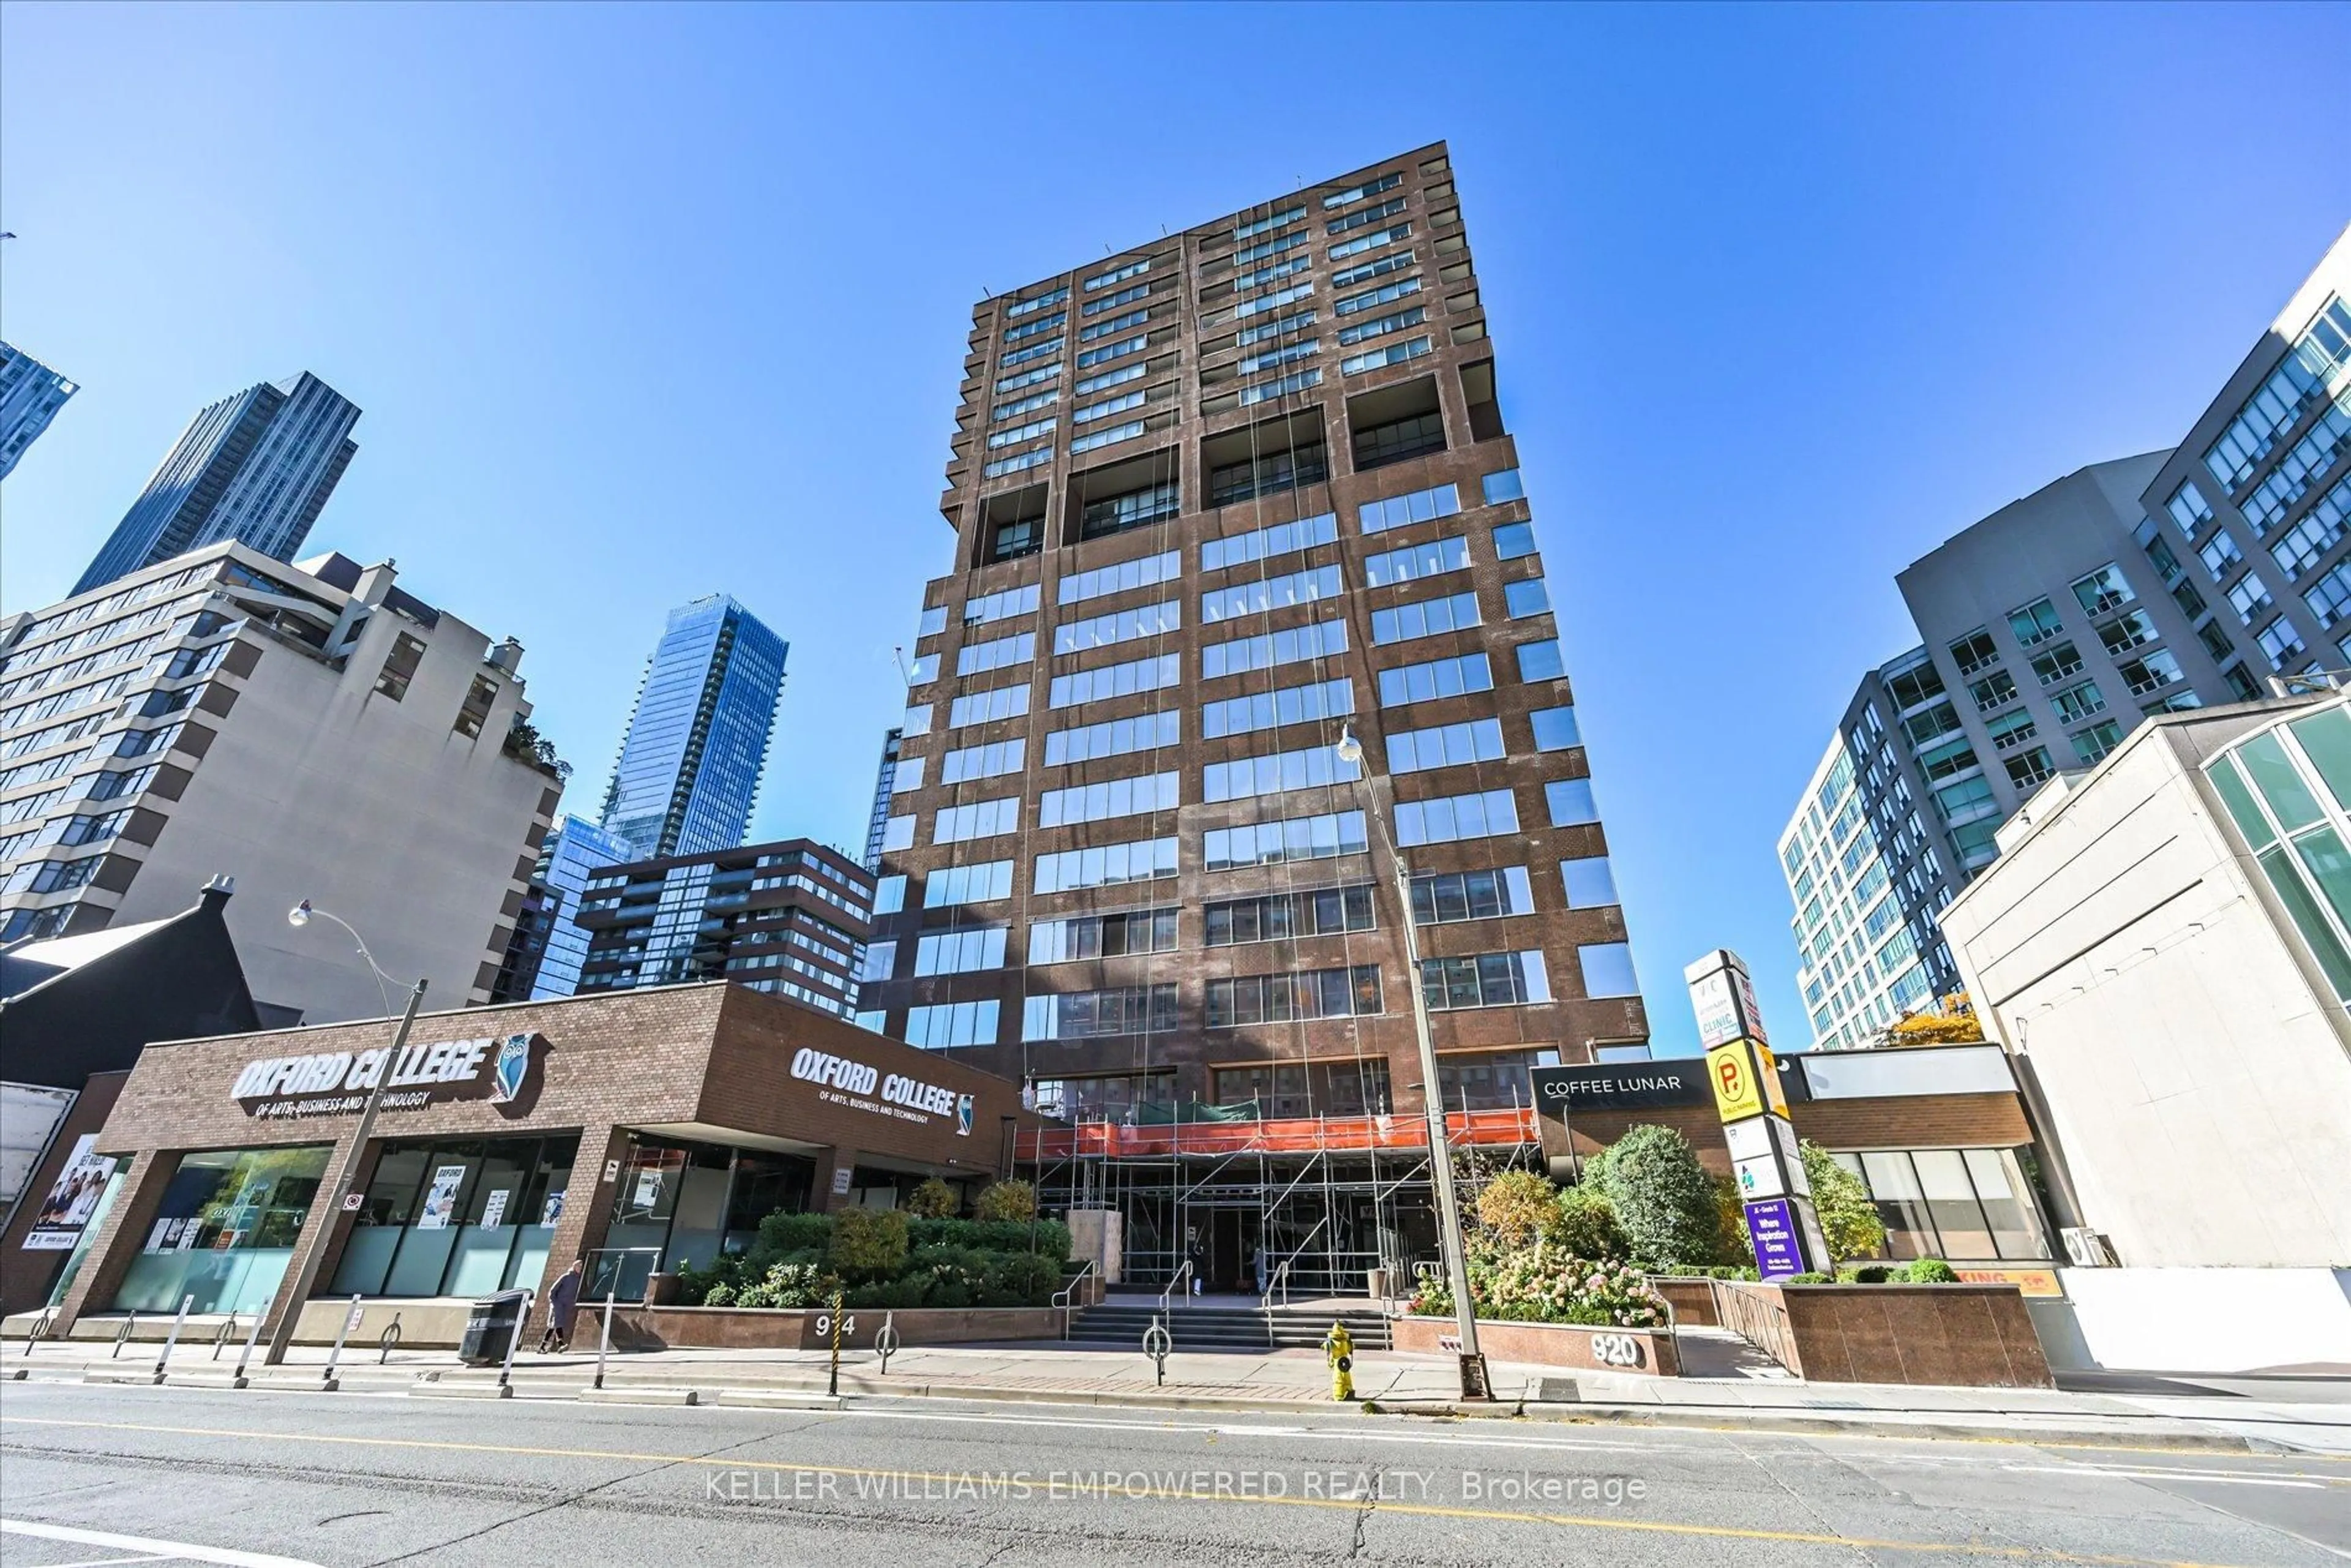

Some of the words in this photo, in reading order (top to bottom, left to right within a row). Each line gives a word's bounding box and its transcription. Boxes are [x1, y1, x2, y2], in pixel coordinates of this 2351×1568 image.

[231, 1051, 353, 1098] OXFORD
[345, 1037, 495, 1091] COLLEGE
[790, 1048, 878, 1095] OXFORD
[881, 1073, 956, 1117] COLLEGE
[1544, 1079, 1614, 1095] COFFEE
[1618, 1076, 1682, 1092] LUNAR
[255, 1103, 269, 1116] OF
[268, 1101, 294, 1115] ARTS,
[296, 1098, 342, 1113] BUSINESS
[340, 1097, 364, 1111] AND
[364, 1092, 430, 1109] THNOLOGY
[819, 1090, 830, 1100] OF
[830, 1092, 849, 1106] ARTS,
[850, 1098, 880, 1114] BUSINESS
[879, 1103, 893, 1116] AND
[893, 1109, 929, 1124] TECHNOLOGY
[438, 1168, 463, 1178] OXFORD
[1959, 1272, 2008, 1283] KING
[816, 1315, 855, 1337] 94
[1591, 1334, 1637, 1365] 920
